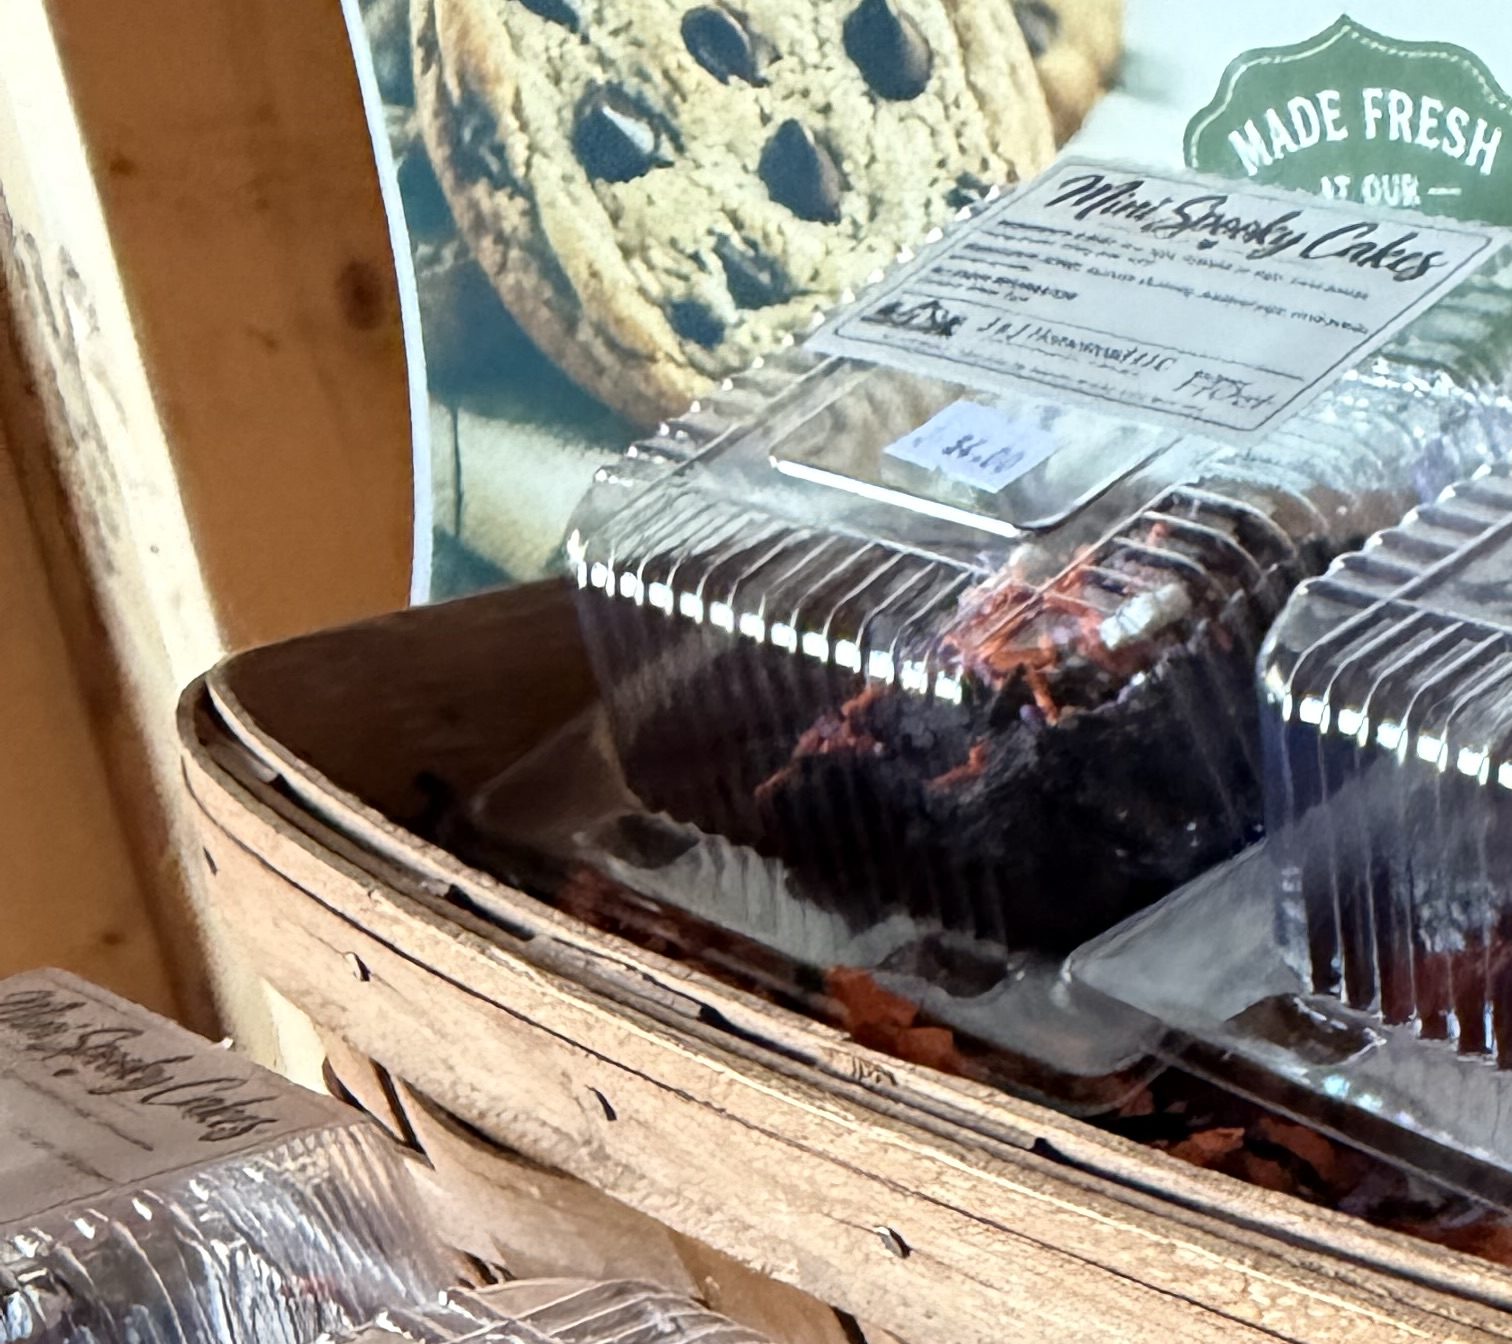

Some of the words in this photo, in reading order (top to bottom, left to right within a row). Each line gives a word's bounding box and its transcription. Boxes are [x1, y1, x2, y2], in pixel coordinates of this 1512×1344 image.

[1228, 89, 1348, 176] MADE
[1362, 87, 1501, 175] FRESH
[1045, 175, 1172, 222] Mini
[1142, 195, 1307, 259] Spooky
[1299, 222, 1448, 283] Cakes
[1361, 173, 1421, 207] OUR
